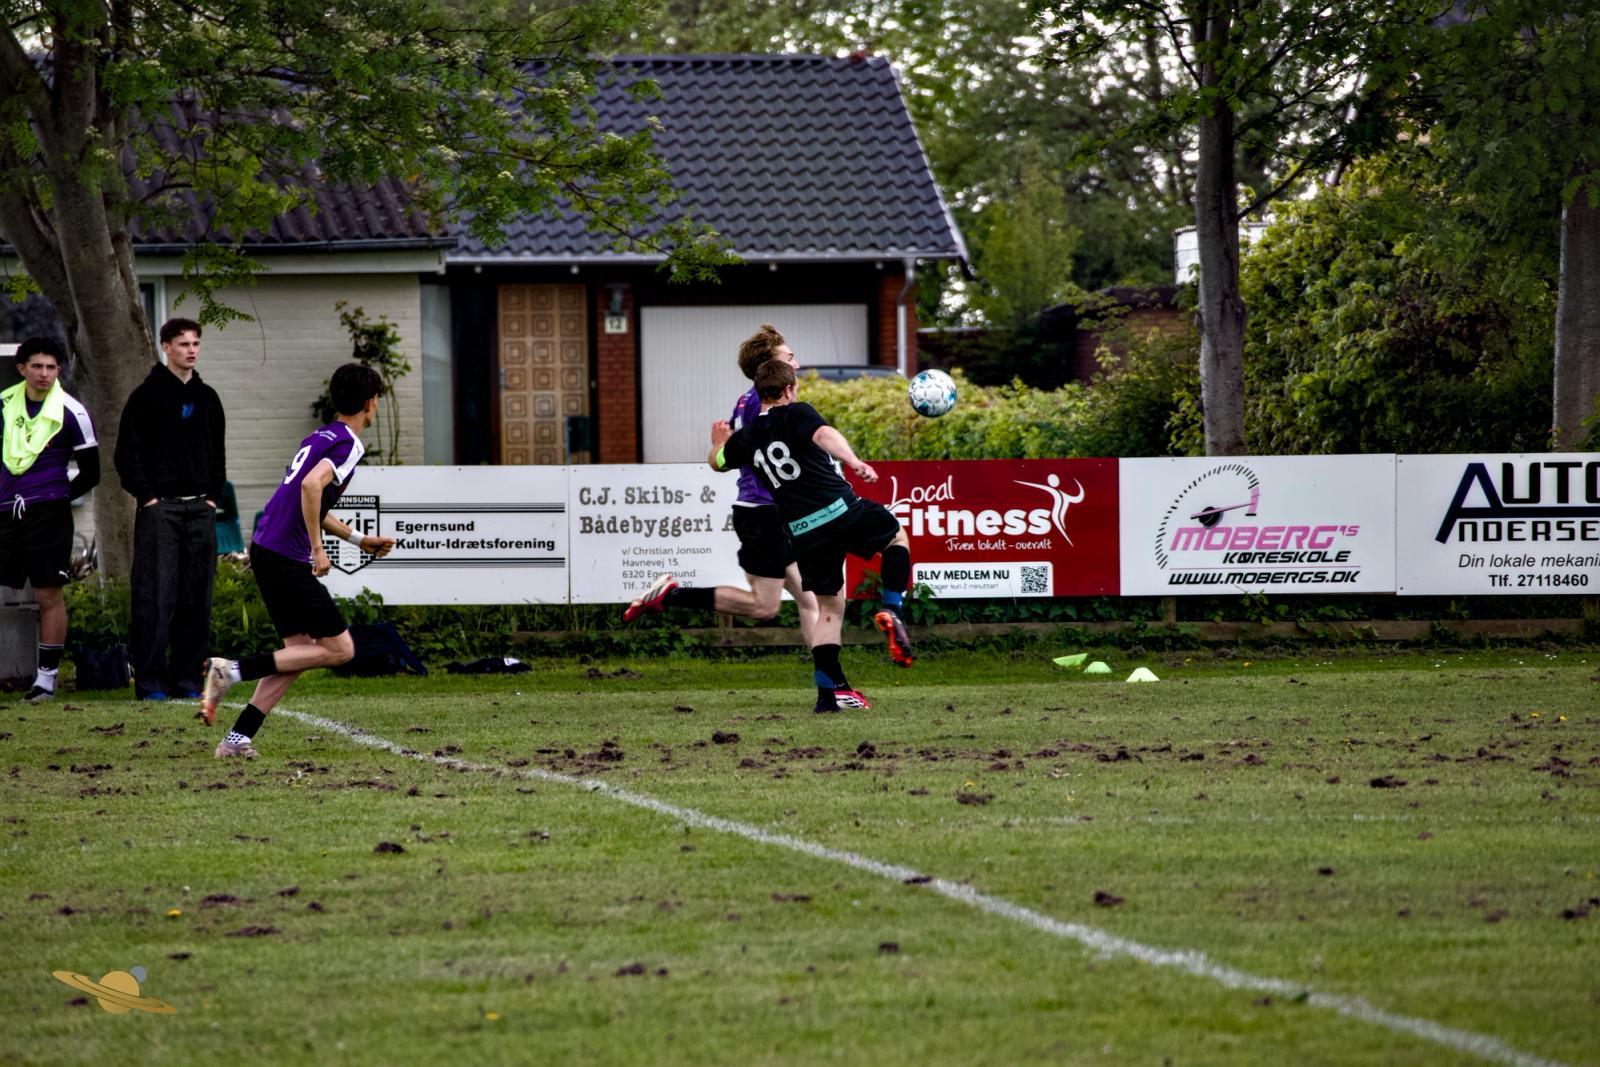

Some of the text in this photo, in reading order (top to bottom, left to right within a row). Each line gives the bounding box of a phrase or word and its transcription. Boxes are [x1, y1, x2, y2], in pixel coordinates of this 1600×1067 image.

[284, 445, 312, 484] 9
[753, 441, 801, 489] 18
[579, 485, 716, 505] C.J. Skibs- &
[889, 475, 955, 509] Local
[396, 521, 474, 534] Egernsund
[579, 514, 713, 537] Bådebyggeri
[396, 538, 555, 551] Kultur-Idrætsforening
[633, 546, 673, 555] Christian
[675, 546, 712, 555] Jonsson
[945, 537, 975, 551] Træn
[978, 539, 1006, 550] lokalt
[1015, 539, 1052, 550] overalt
[622, 558, 665, 568] Havnevej
[1222, 551, 1351, 564] KØRESKOLE
[1459, 553, 1600, 567] Din lokale mekani
[622, 570, 644, 579] 6320
[917, 569, 1010, 580] BLIV MEDLEM NU
[1489, 574, 1589, 587] Tlf. 27118460
[623, 581, 637, 590] Tlf.
